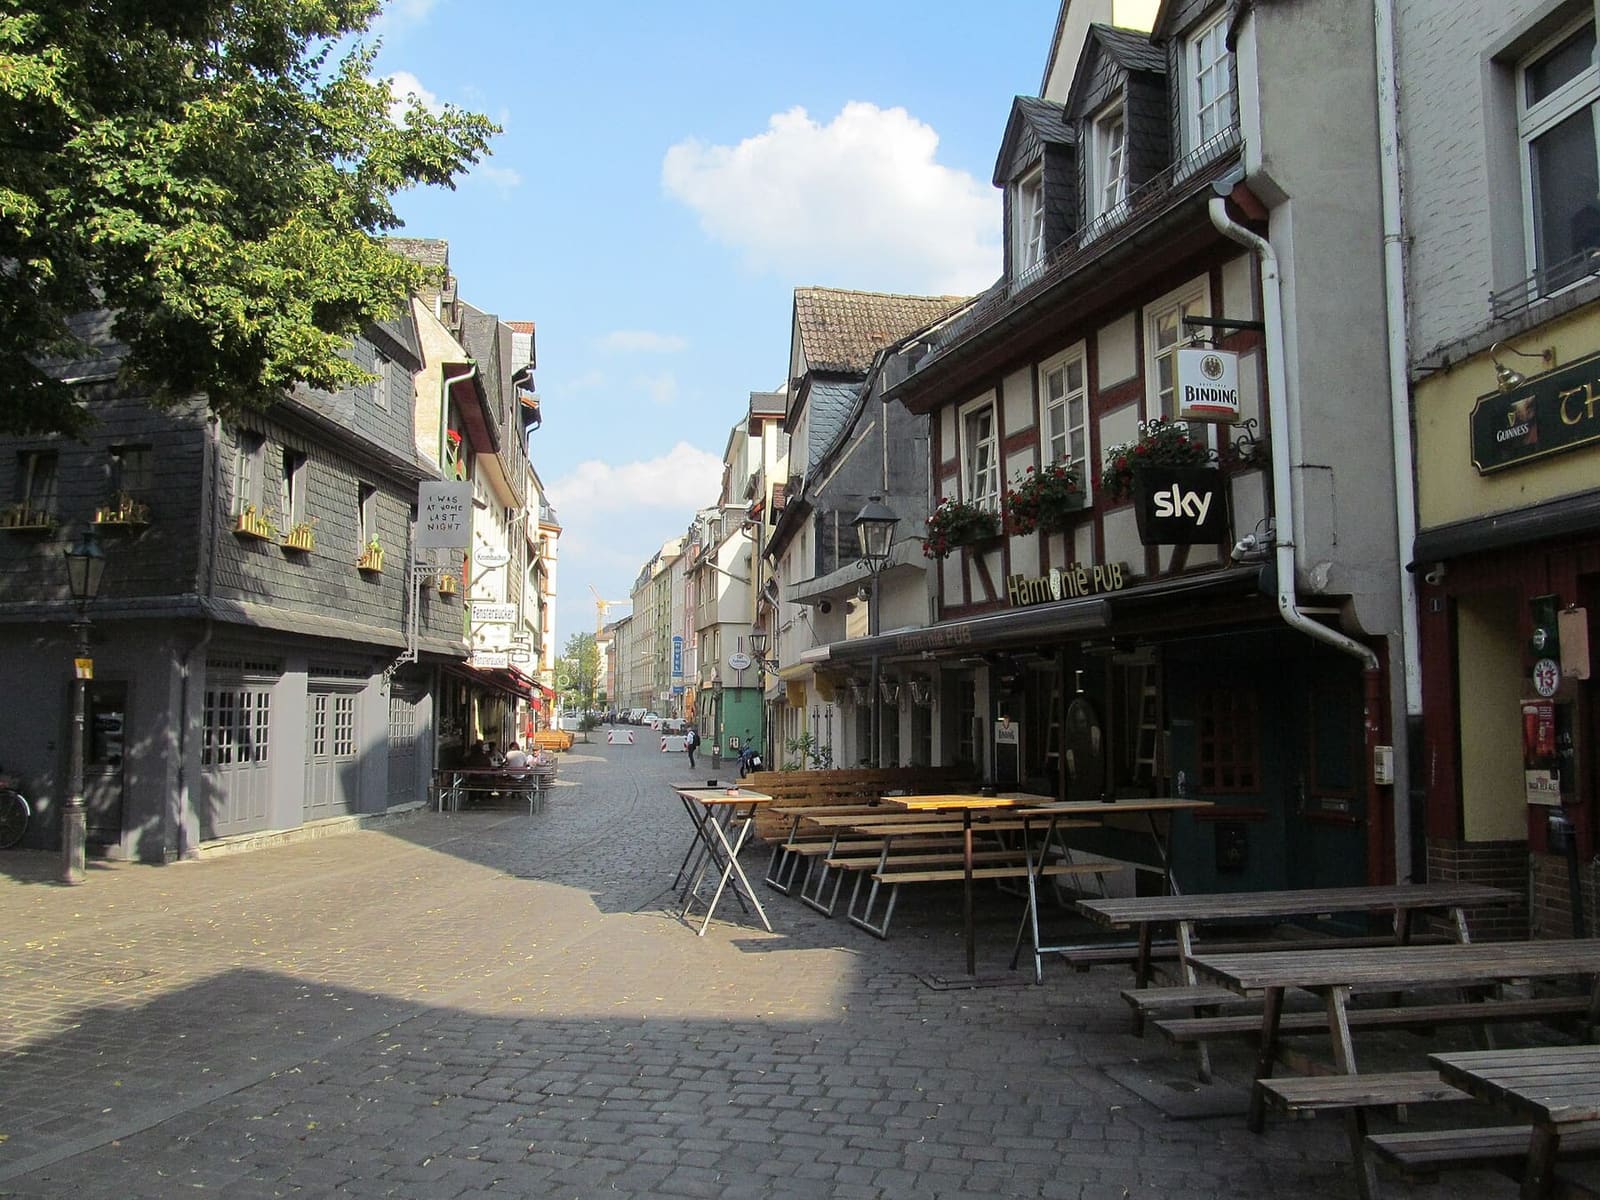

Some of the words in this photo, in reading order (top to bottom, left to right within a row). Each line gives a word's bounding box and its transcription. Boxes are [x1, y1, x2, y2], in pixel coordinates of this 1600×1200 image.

[1184, 385, 1238, 406] BINDING
[1496, 423, 1530, 442] GUINNESS
[437, 495, 458, 504] WAS
[440, 504, 463, 512] HOME
[1153, 483, 1213, 526] sky
[430, 513, 458, 522] LAST
[427, 523, 461, 531] NIGHT
[1093, 562, 1124, 593] PUB
[1537, 670, 1555, 688] 13
